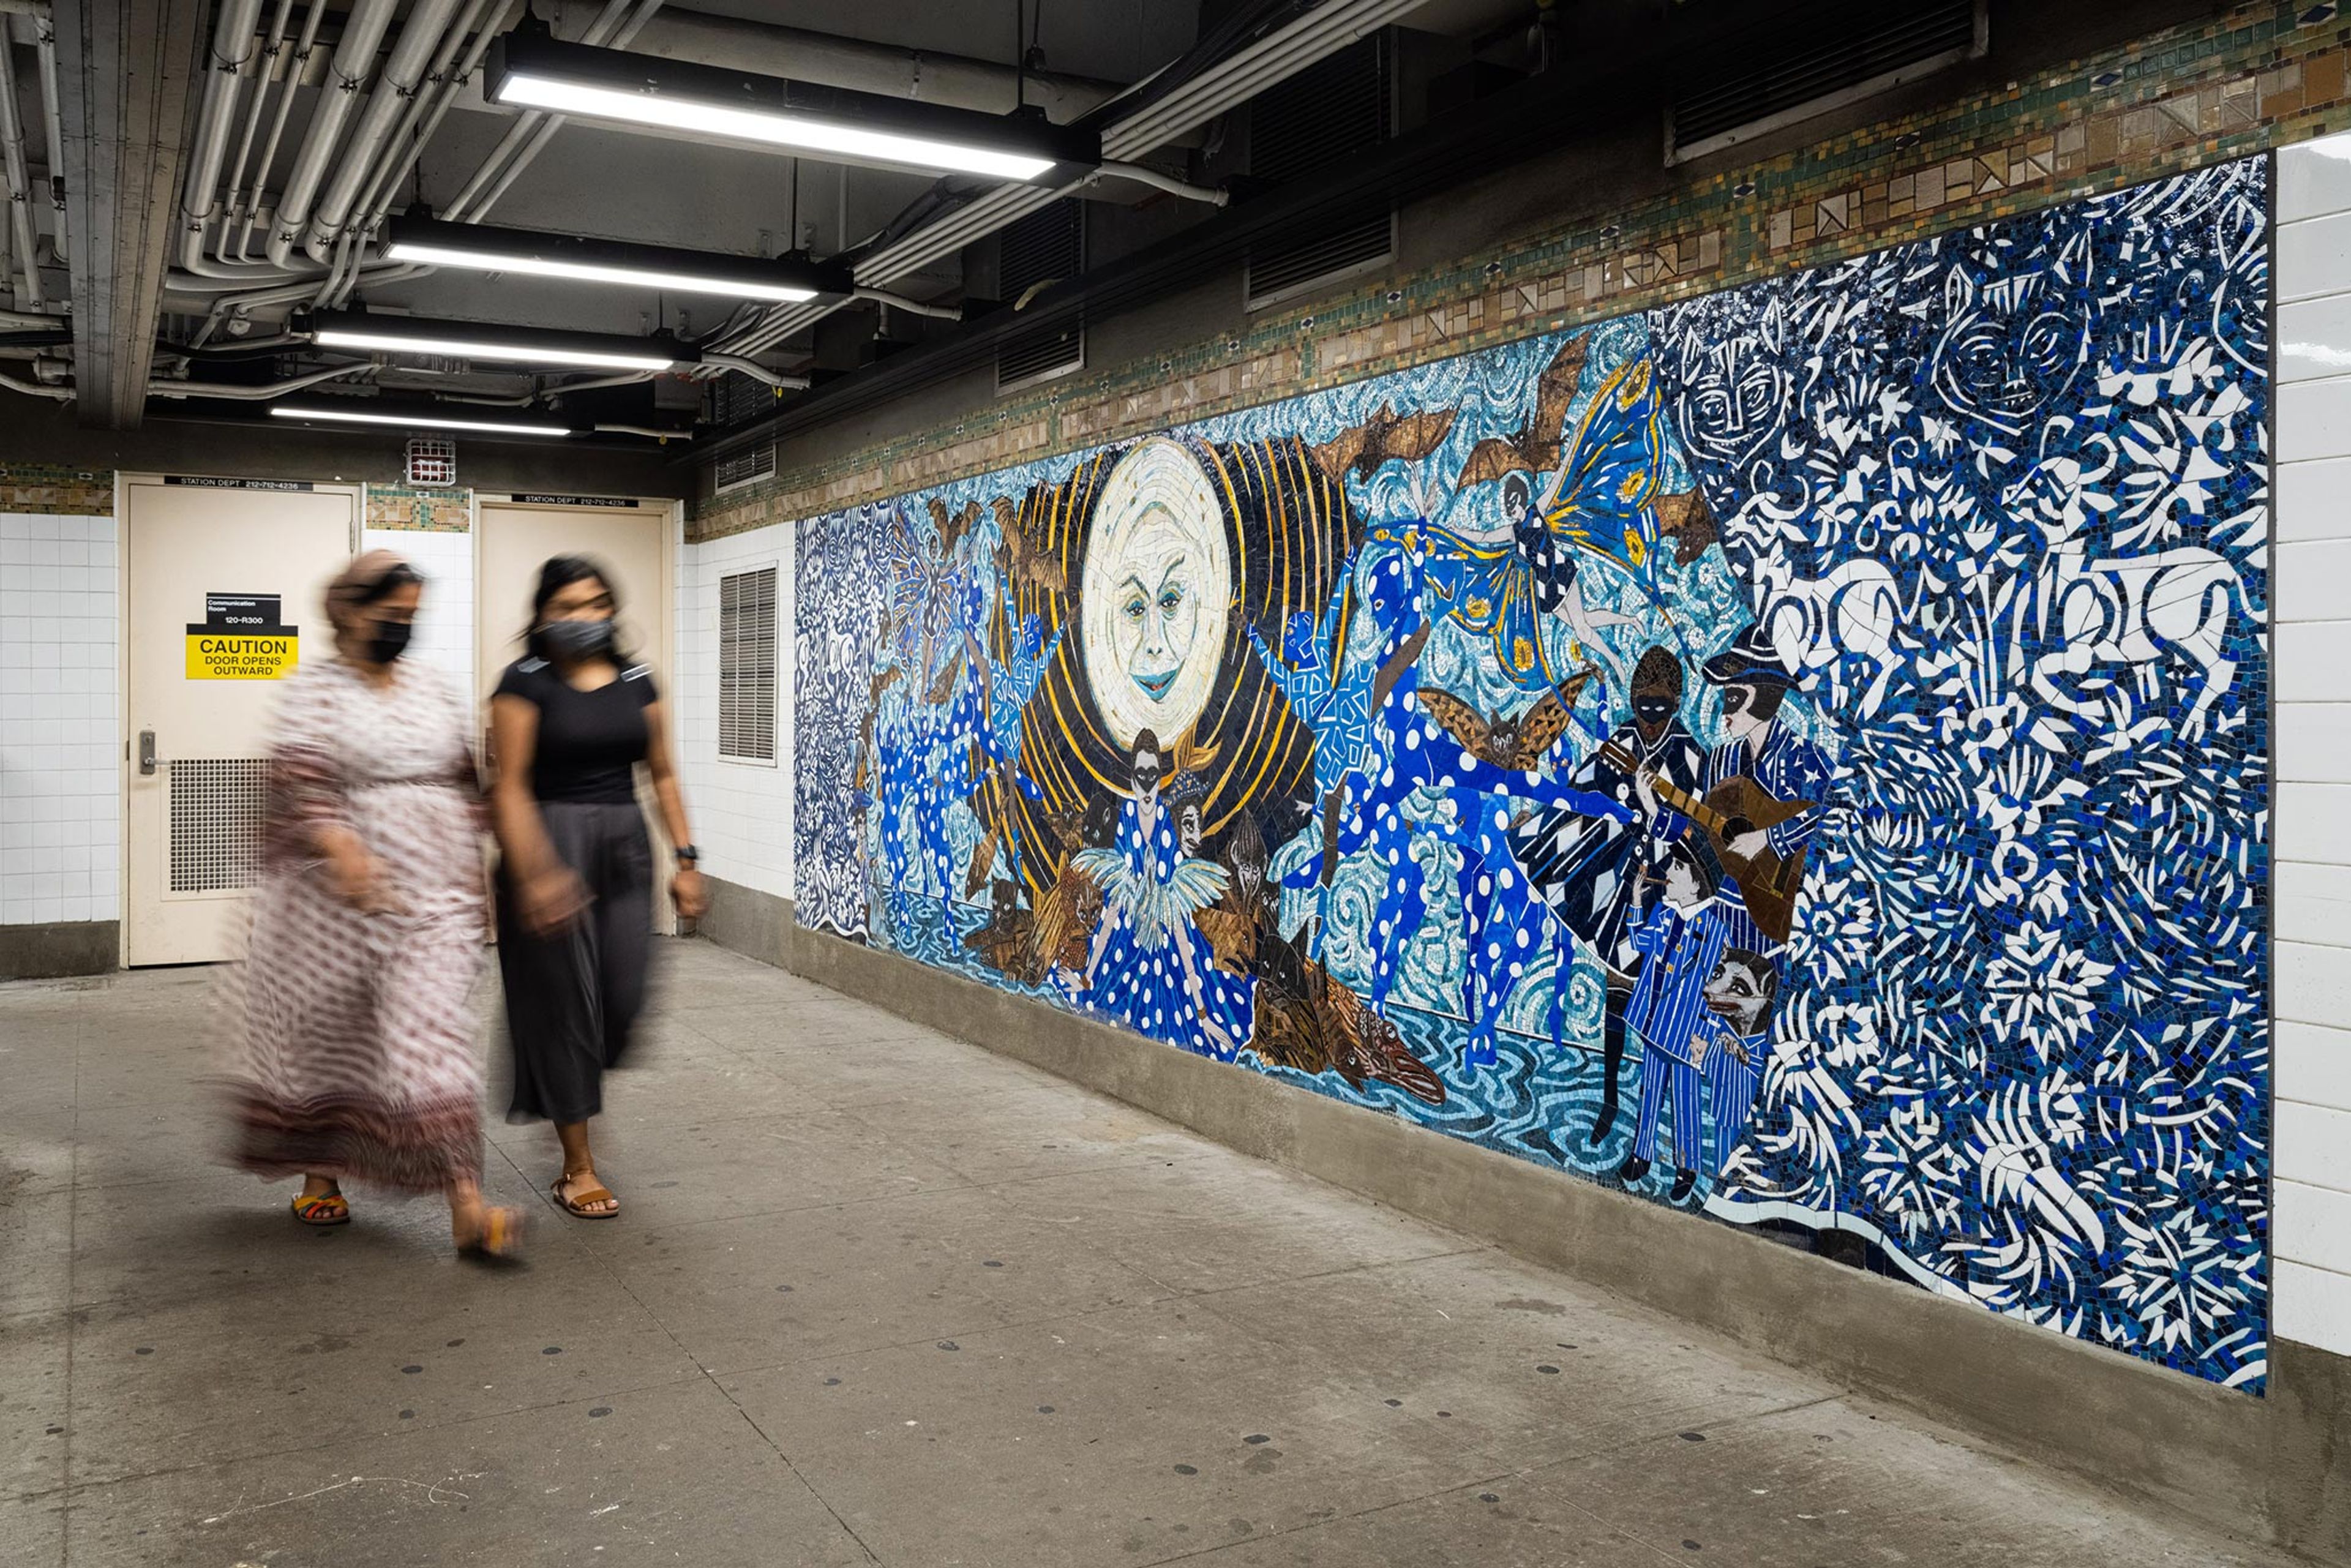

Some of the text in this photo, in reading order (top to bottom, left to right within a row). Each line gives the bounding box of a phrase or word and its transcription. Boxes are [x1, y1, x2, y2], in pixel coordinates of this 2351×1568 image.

[181, 478, 216, 486] STATION
[200, 640, 287, 654] CAUTION
[205, 656, 282, 666] DOOR OPENS
[214, 667, 272, 675] OUTWARD
